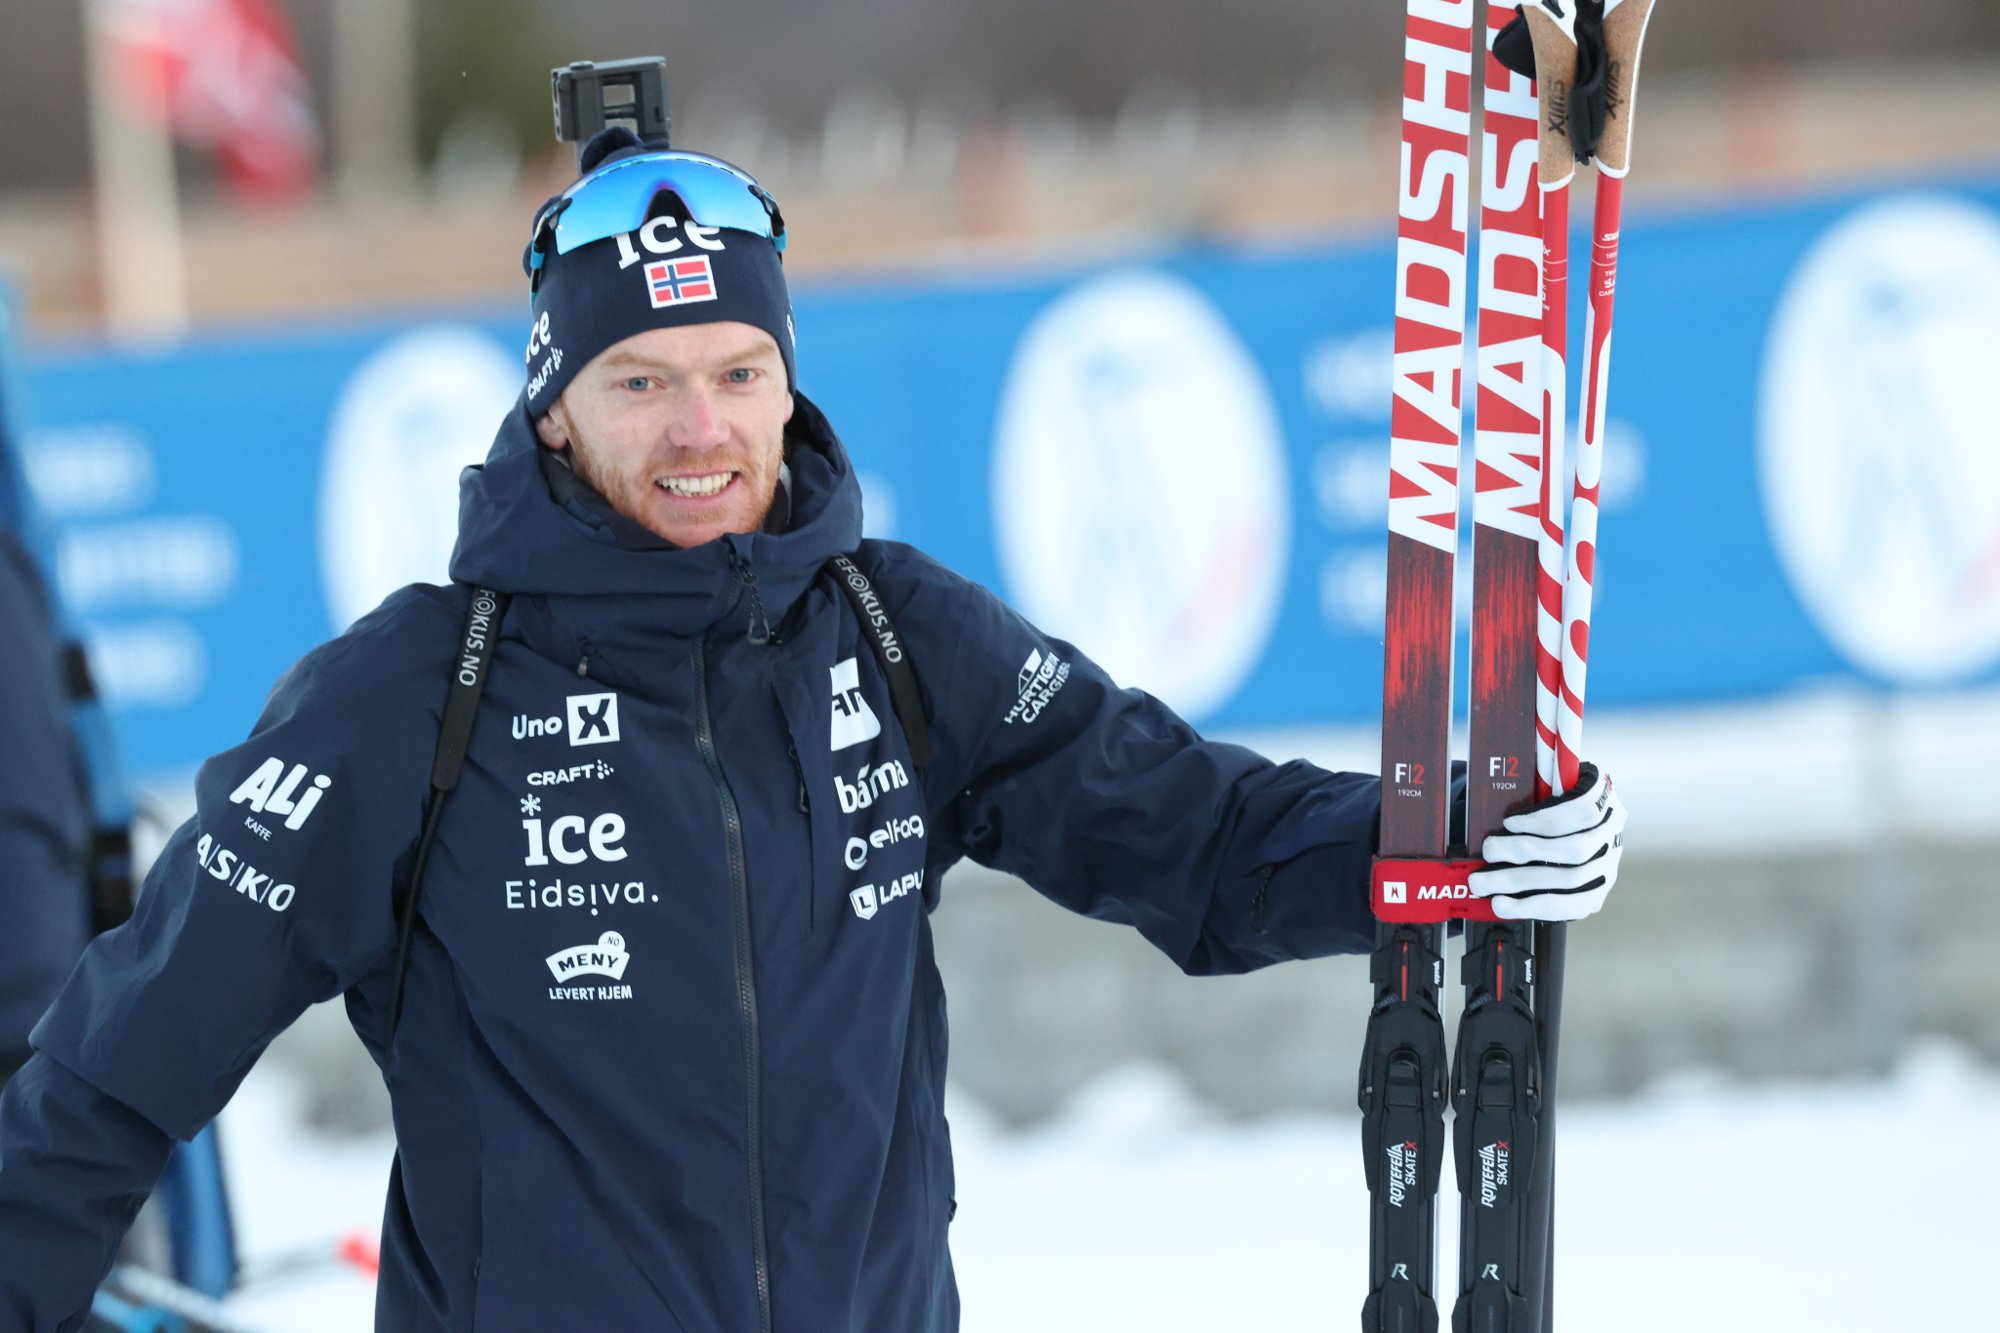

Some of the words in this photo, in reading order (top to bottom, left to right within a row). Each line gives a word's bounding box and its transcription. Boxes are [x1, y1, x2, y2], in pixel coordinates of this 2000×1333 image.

[1473, 0, 1545, 543] MADSH
[527, 356, 553, 401] CRAFT
[511, 713, 563, 741] Uno
[574, 696, 613, 742] X
[526, 764, 595, 786] CRAFT
[1491, 781, 1517, 791] 192CM
[1397, 788, 1422, 798] 192CM
[244, 816, 273, 842] KAFFE
[520, 794, 628, 867] ice
[869, 814, 925, 849] elfag
[557, 952, 619, 973] MENY
[548, 987, 595, 1000] LEVERT
[598, 985, 633, 1000] HJEM
[1391, 1263, 1409, 1281] R
[1481, 1263, 1500, 1281] R
